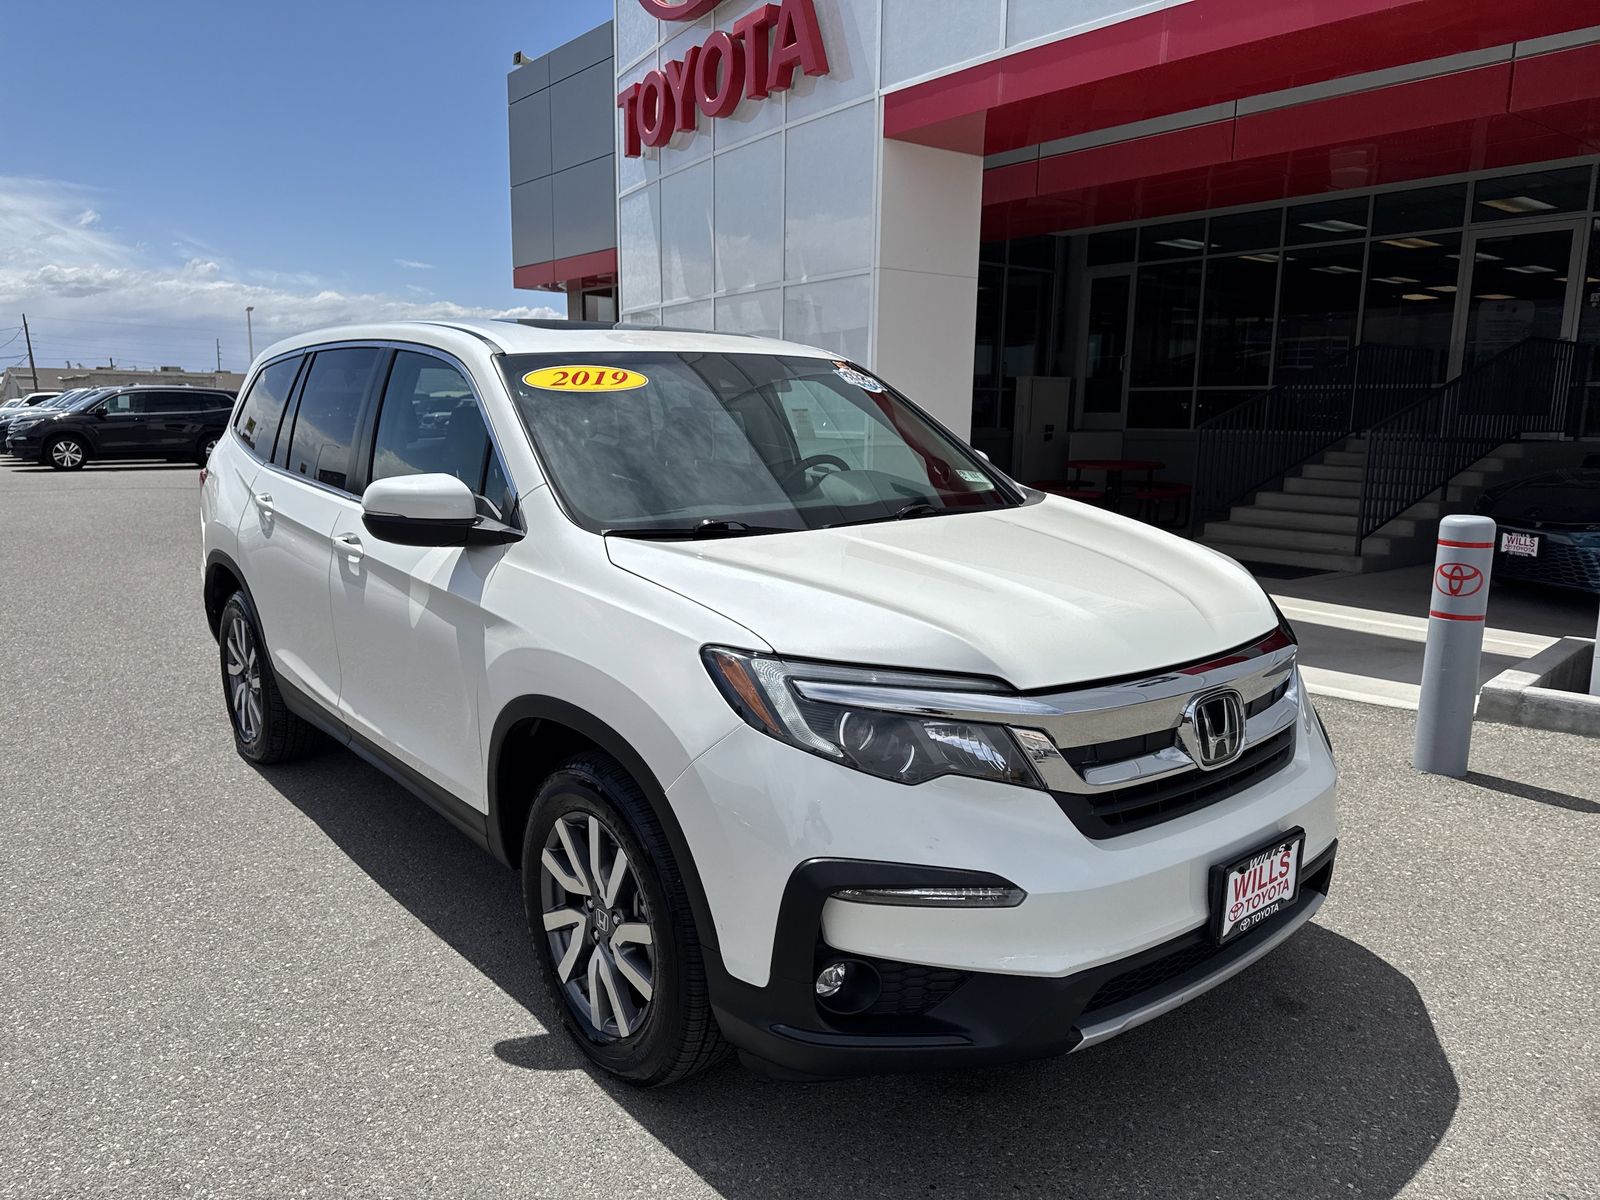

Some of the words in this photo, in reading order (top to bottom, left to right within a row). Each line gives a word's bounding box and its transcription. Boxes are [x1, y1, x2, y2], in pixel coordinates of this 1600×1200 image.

[617, 0, 830, 158] TOYOTA
[551, 370, 629, 386] 2019
[1507, 536, 1536, 547] WILLS
[1513, 544, 1535, 553] TOYOTA
[1234, 851, 1291, 902] WILLS
[1245, 878, 1290, 913] TOYOTA
[1251, 903, 1280, 925] TOYOTA
